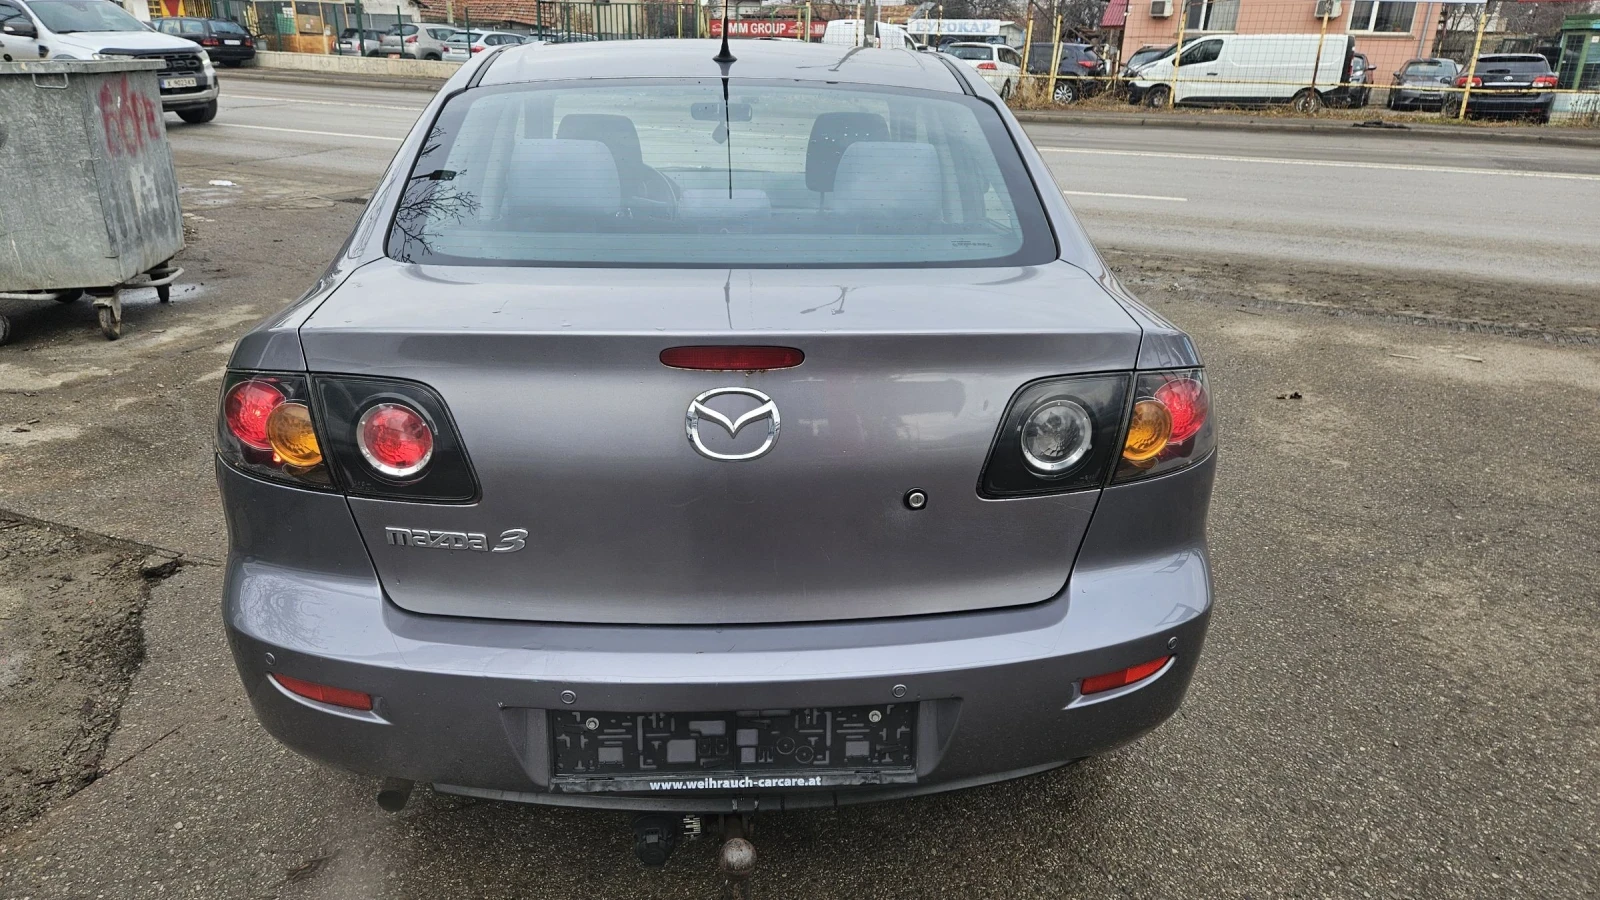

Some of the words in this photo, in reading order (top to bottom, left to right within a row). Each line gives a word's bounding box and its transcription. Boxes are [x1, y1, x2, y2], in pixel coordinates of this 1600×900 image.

[728, 22, 748, 34] MM
[750, 22, 786, 34] GROUP
[166, 60, 199, 68] ORD
[491, 528, 529, 553] 3
[649, 776, 822, 790] www.weihrauch-carcare.at
